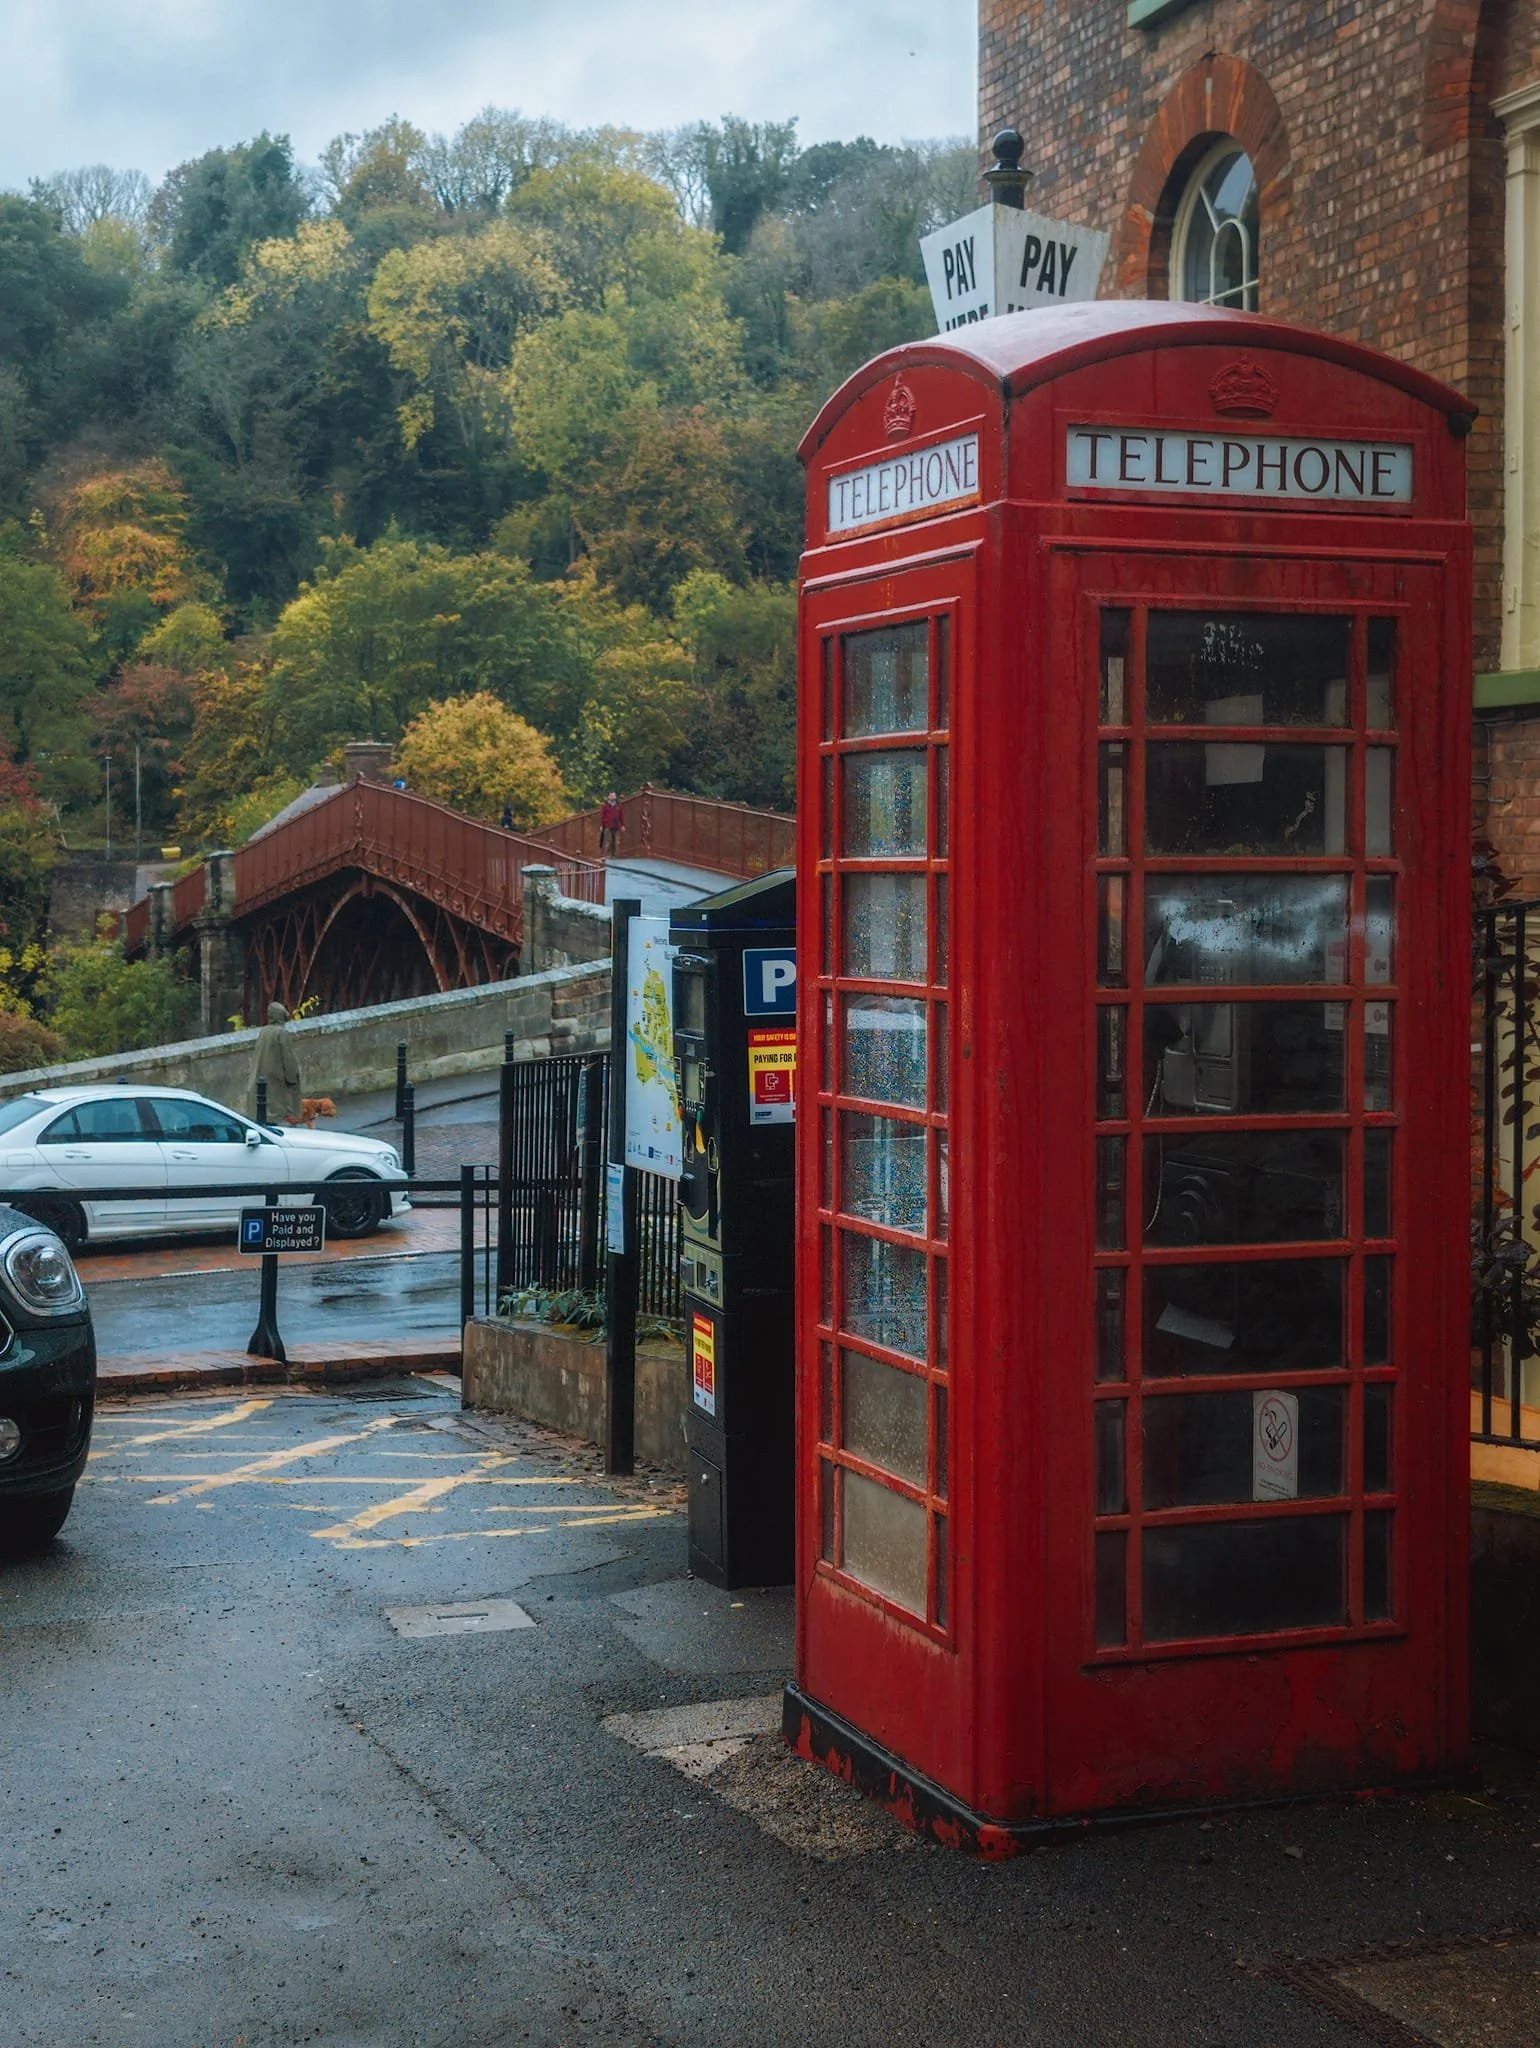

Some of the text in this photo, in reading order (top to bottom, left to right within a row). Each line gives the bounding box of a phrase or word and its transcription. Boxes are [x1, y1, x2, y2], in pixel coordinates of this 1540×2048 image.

[943, 236, 976, 300] PAY
[1020, 235, 1077, 297] PAY
[836, 441, 976, 523] TELEPHONE
[1075, 432, 1397, 497] TELEPHONE
[761, 960, 796, 1003] P
[754, 1054, 778, 1064] PAYING
[780, 1053, 792, 1063] FOR
[248, 1222, 260, 1240] P
[271, 1212, 316, 1223] Have you
[272, 1224, 314, 1235] Paid and
